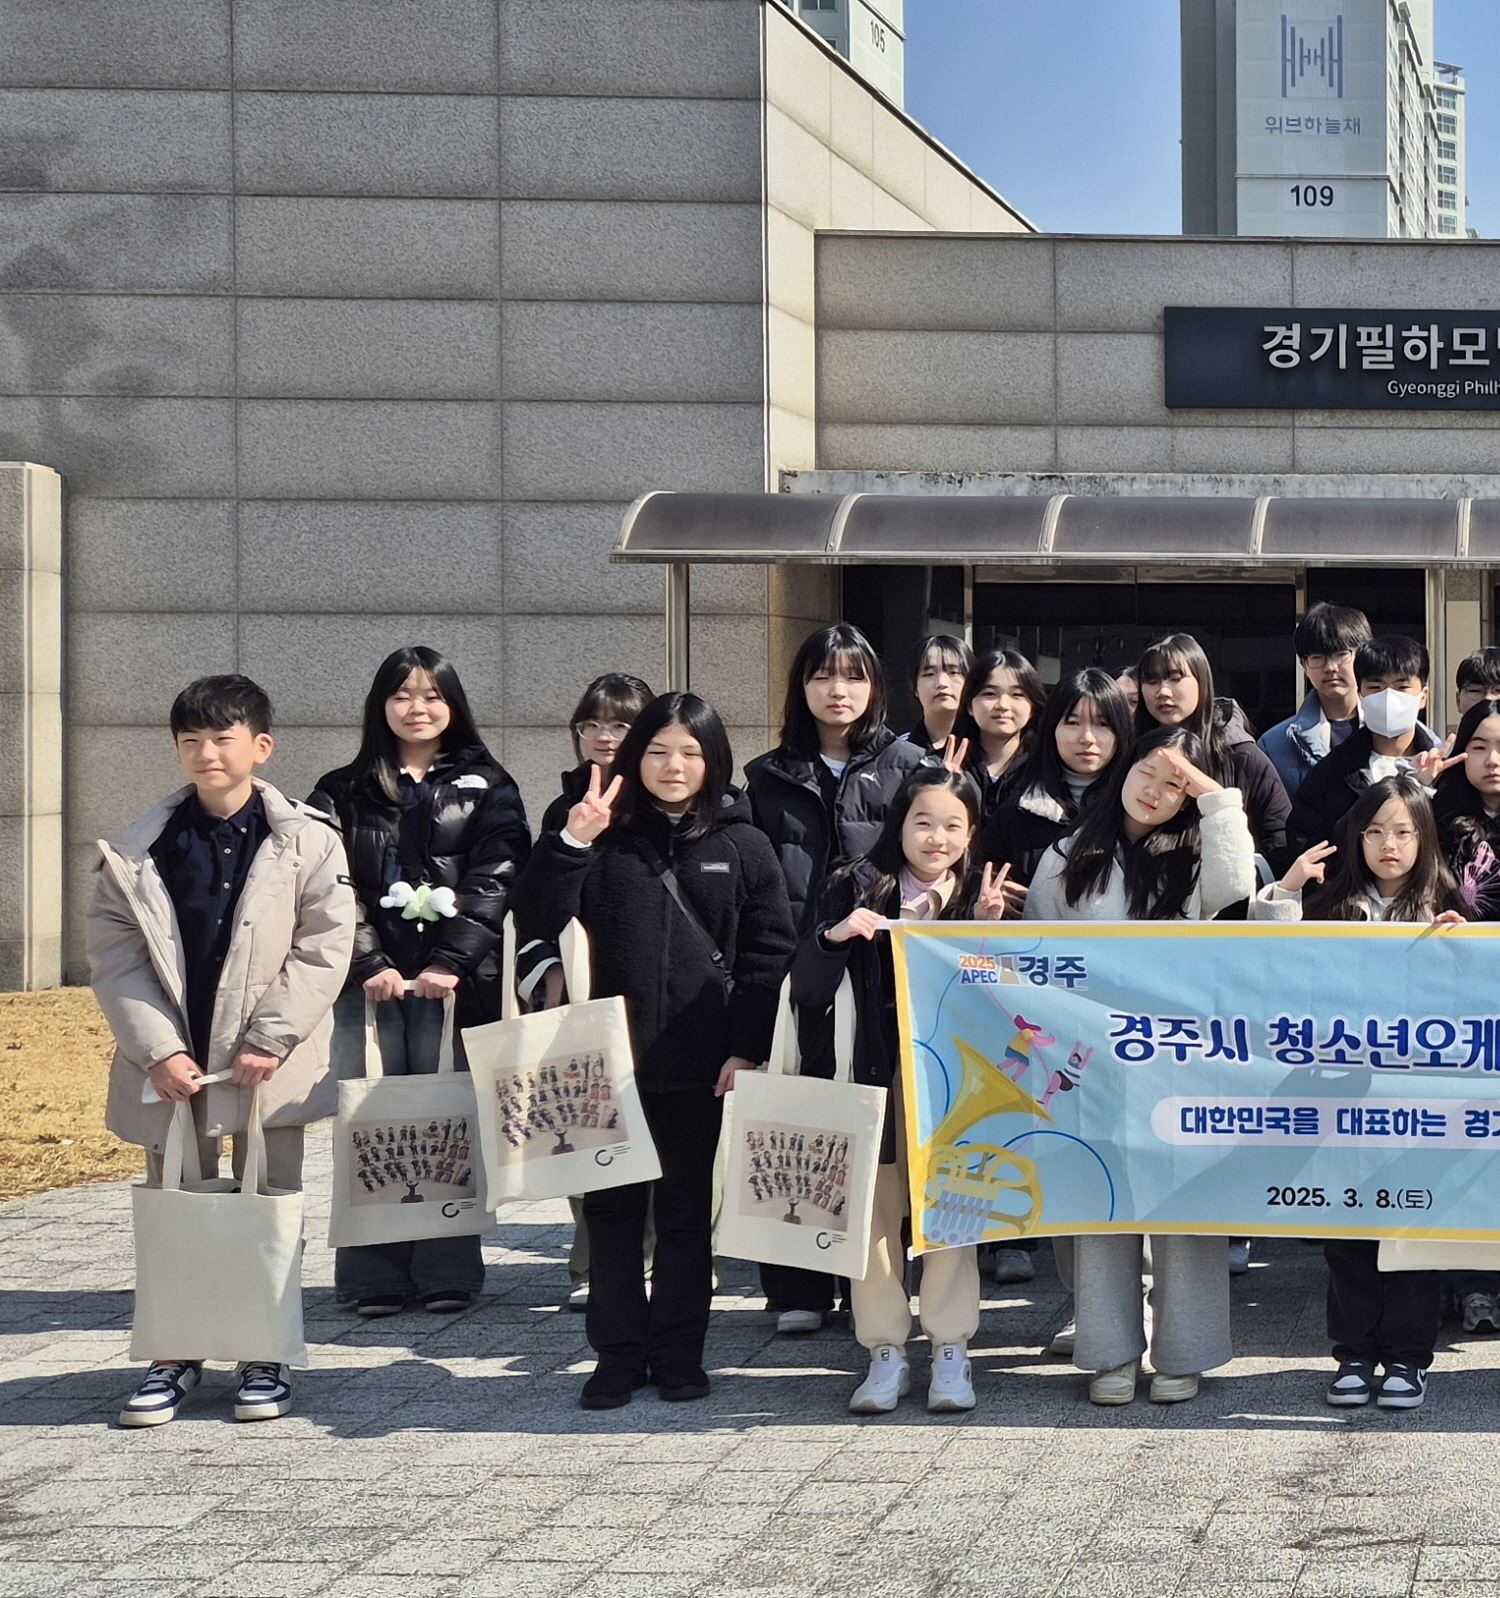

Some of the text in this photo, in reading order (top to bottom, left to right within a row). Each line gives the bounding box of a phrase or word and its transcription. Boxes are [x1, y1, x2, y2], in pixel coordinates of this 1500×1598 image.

[870, 20, 885, 53] 105
[1265, 116, 1361, 135] 위브하늘채
[1290, 185, 1335, 207] 109
[1387, 380, 1460, 398] Gyeonggi
[960, 955, 996, 970] 2025
[1018, 956, 1087, 988] 경주
[960, 969, 998, 984] APEC
[1109, 1014, 1249, 1062] 경주시
[1181, 1106, 1319, 1135] 대한민국을
[1337, 1107, 1447, 1137] 대표하는
[1266, 1186, 1433, 1210] 2025. 3. 8.(토)
